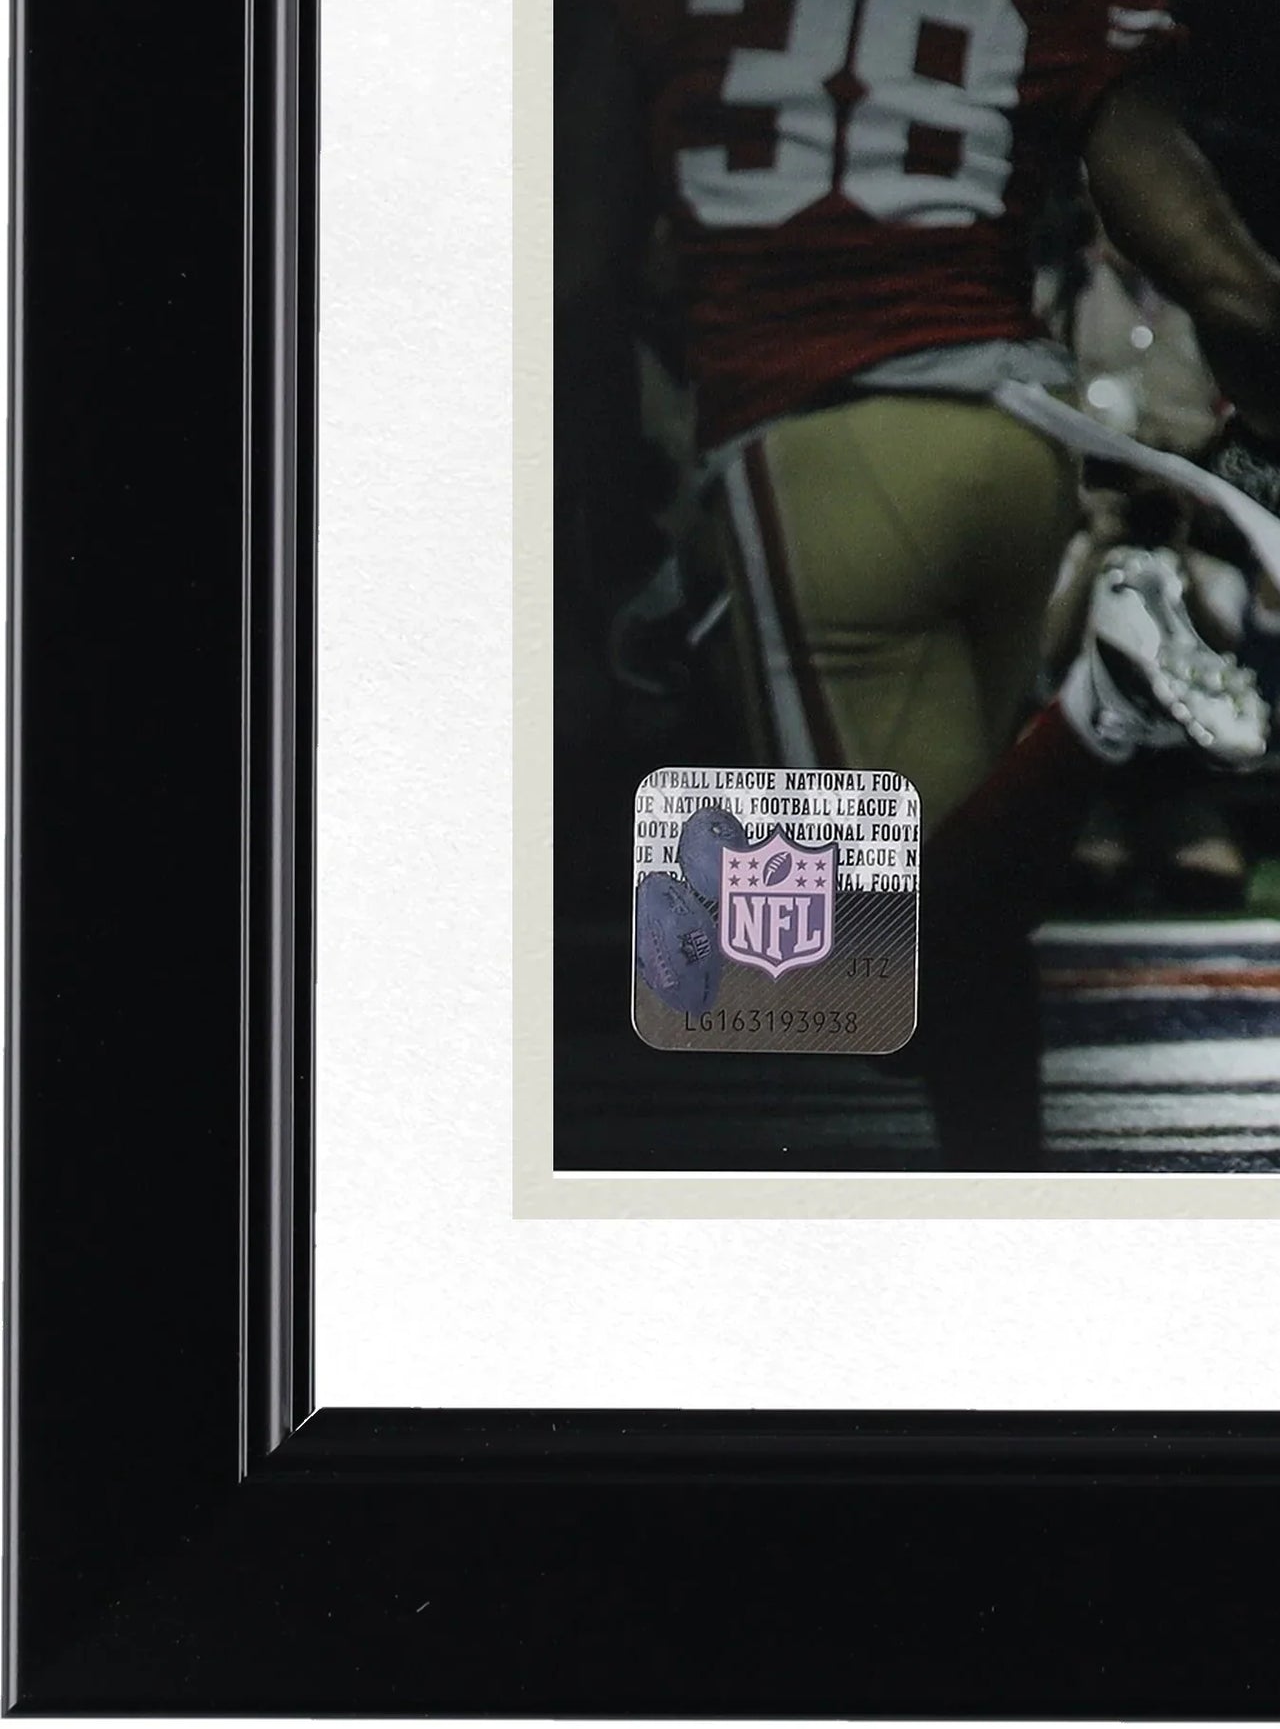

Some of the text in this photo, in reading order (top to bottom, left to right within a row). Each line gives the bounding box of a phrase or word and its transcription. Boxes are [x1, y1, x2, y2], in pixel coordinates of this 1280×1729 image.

[715, 771, 776, 790] LEAGUE
[785, 773, 866, 791] NATIONAL
[663, 796, 744, 814] NATIONAL
[750, 797, 832, 816] FOOTBALL
[836, 798, 898, 817] LEAGUE
[784, 822, 865, 842] NATIONAL
[732, 895, 822, 961] NFL
[846, 957, 890, 980] JTZ
[684, 1009, 859, 1035] LG163193938
